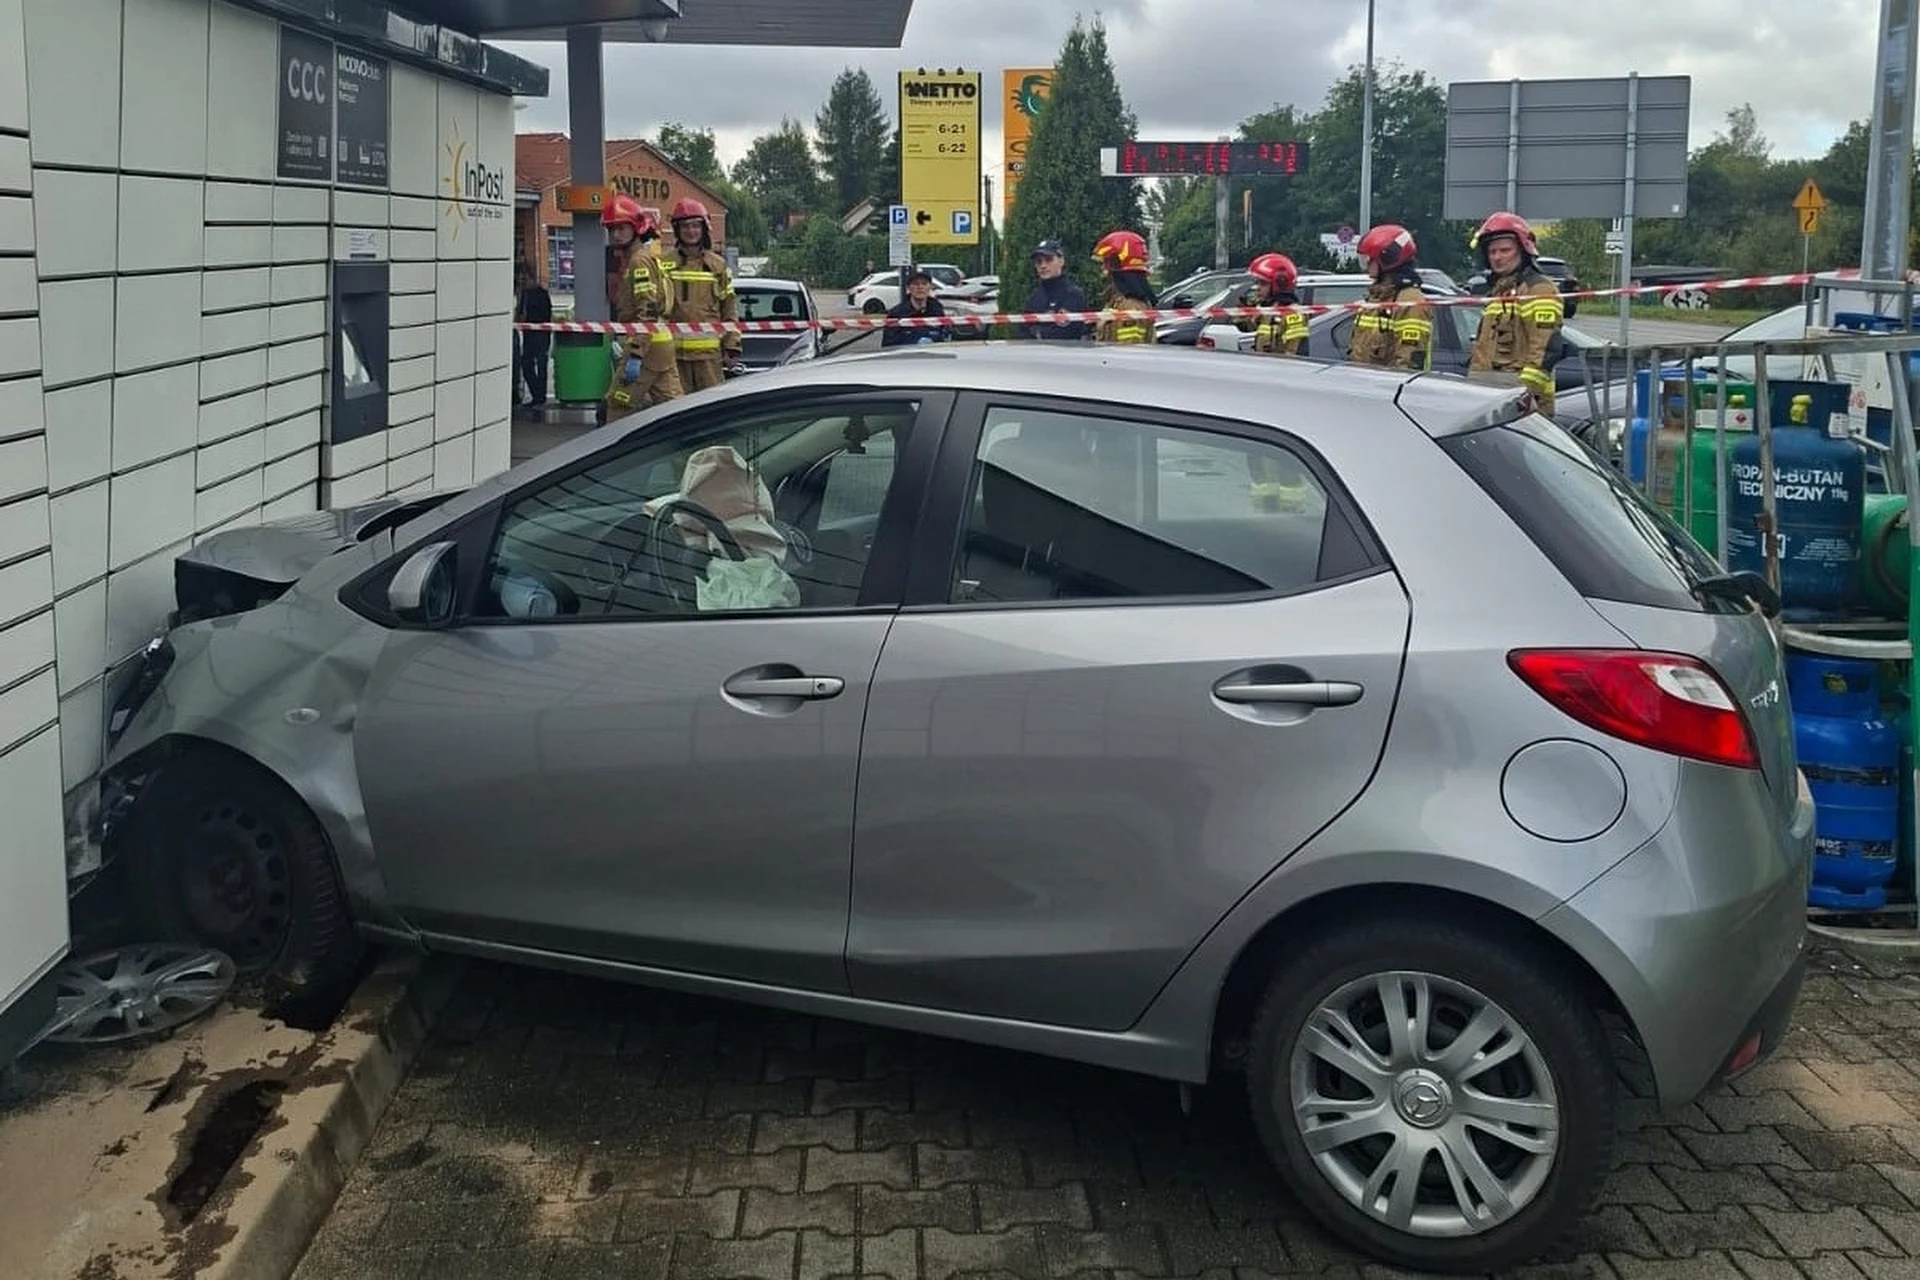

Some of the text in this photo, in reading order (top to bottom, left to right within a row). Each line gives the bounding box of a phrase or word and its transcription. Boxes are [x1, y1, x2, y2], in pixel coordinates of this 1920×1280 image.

[288, 58, 326, 104] CCC
[913, 82, 977, 98] NETTO
[465, 161, 503, 200] InPost
[620, 175, 669, 199] NETTO
[895, 209, 906, 223] P
[954, 212, 970, 233] P
